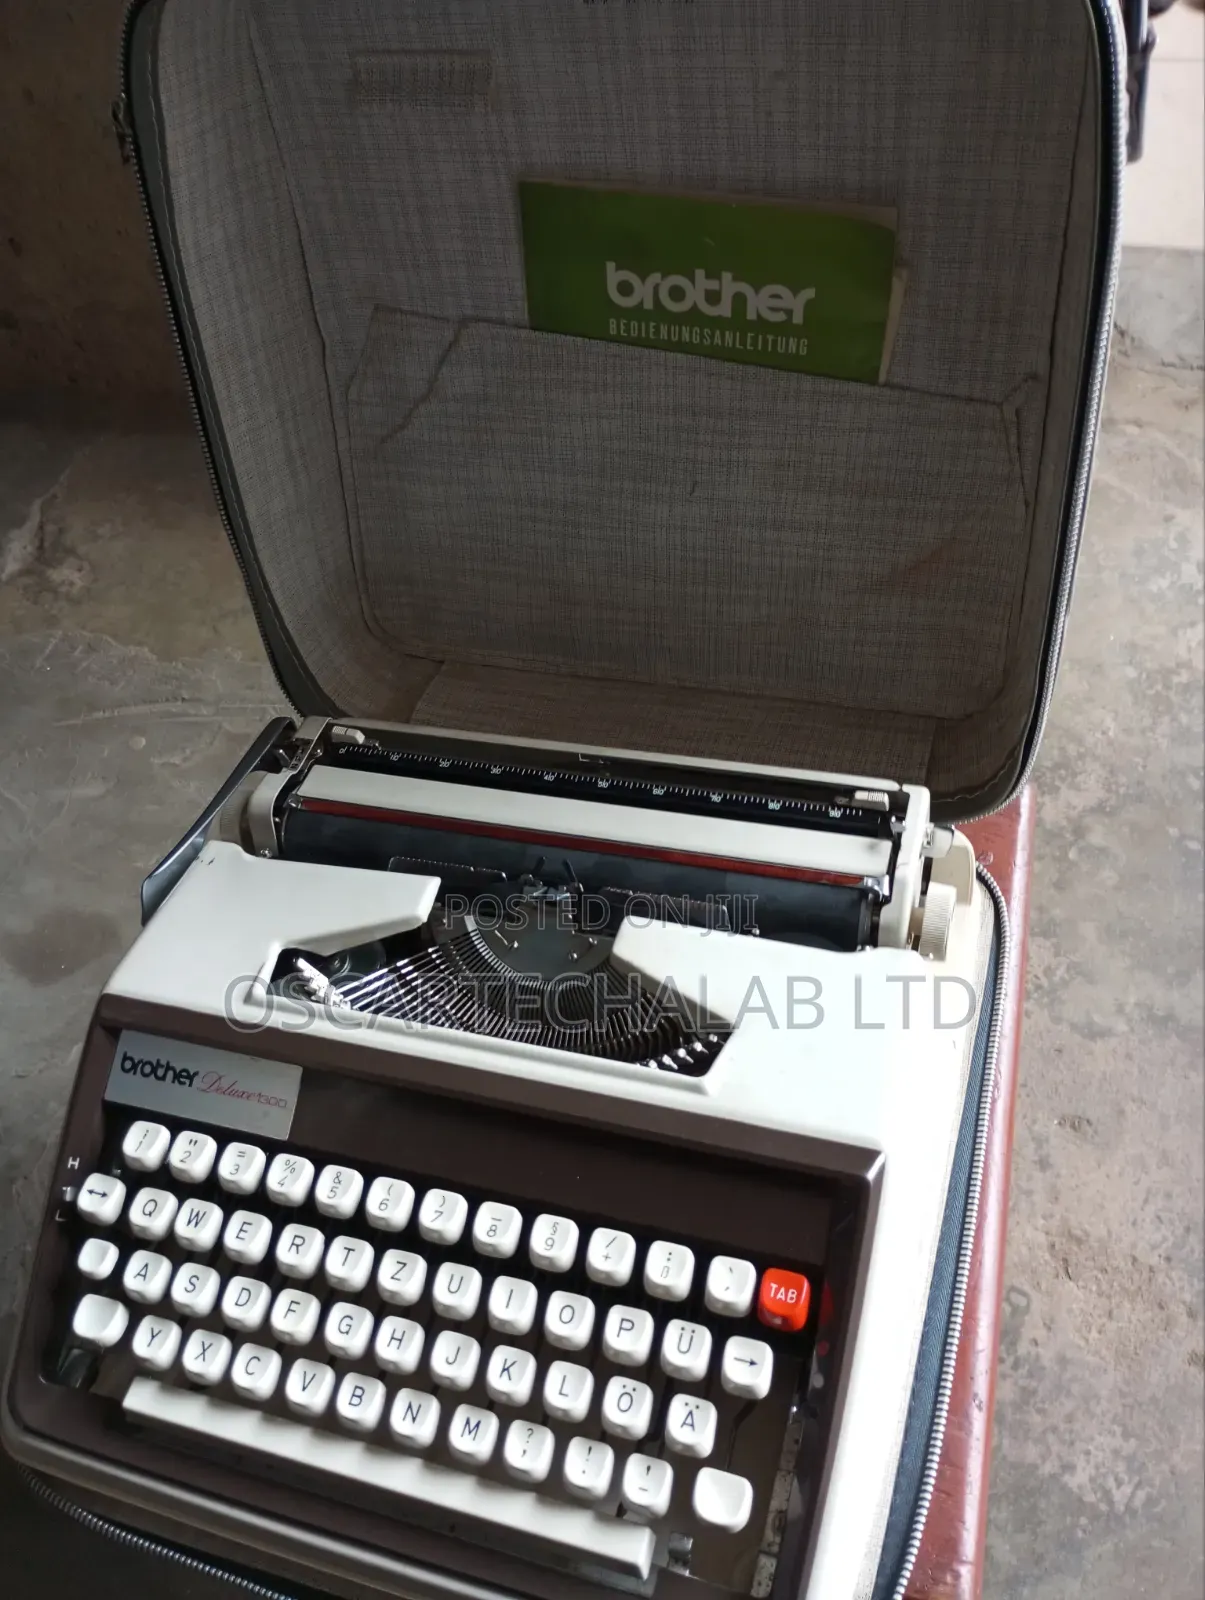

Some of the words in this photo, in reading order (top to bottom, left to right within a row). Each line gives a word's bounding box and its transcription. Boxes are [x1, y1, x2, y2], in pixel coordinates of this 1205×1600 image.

[606, 261, 816, 325] brother
[609, 318, 808, 355] BEDIENUNGSANLEITUNG
[120, 1051, 200, 1087] brother
[67, 1156, 80, 1170] H
[284, 1159, 296, 1174] %
[333, 1171, 342, 1184] &
[180, 1151, 191, 1163] 2
[230, 1164, 240, 1175] 3
[278, 1176, 288, 1187] 4
[328, 1186, 338, 1199] 5
[379, 1198, 389, 1211] 6
[431, 1210, 444, 1222] 7
[487, 1225, 497, 1237] 8
[545, 1237, 555, 1250] 9
[770, 1282, 797, 1304] TAB
[143, 1199, 157, 1217] Q
[187, 1208, 205, 1228] W
[236, 1221, 253, 1240] E
[288, 1235, 305, 1254] R
[343, 1247, 355, 1266] T
[391, 1261, 407, 1281] Z
[448, 1274, 464, 1294] U
[506, 1289, 513, 1308] I
[559, 1305, 575, 1324] O
[617, 1318, 635, 1337] P
[678, 1327, 695, 1354] Ü
[134, 1263, 149, 1281] A
[185, 1275, 198, 1293] S
[235, 1287, 251, 1306] D
[284, 1300, 301, 1318] F
[338, 1315, 353, 1335] G
[387, 1328, 406, 1349] H
[446, 1346, 461, 1365] J
[500, 1359, 517, 1380] K
[559, 1375, 568, 1397] L
[617, 1385, 636, 1412] Ö
[681, 1402, 700, 1431] Ä
[148, 1327, 162, 1347] Y
[195, 1341, 213, 1362] X
[245, 1356, 261, 1375] C
[302, 1371, 316, 1391] V
[349, 1385, 364, 1406] B
[403, 1401, 421, 1423] N
[461, 1417, 481, 1440] M
